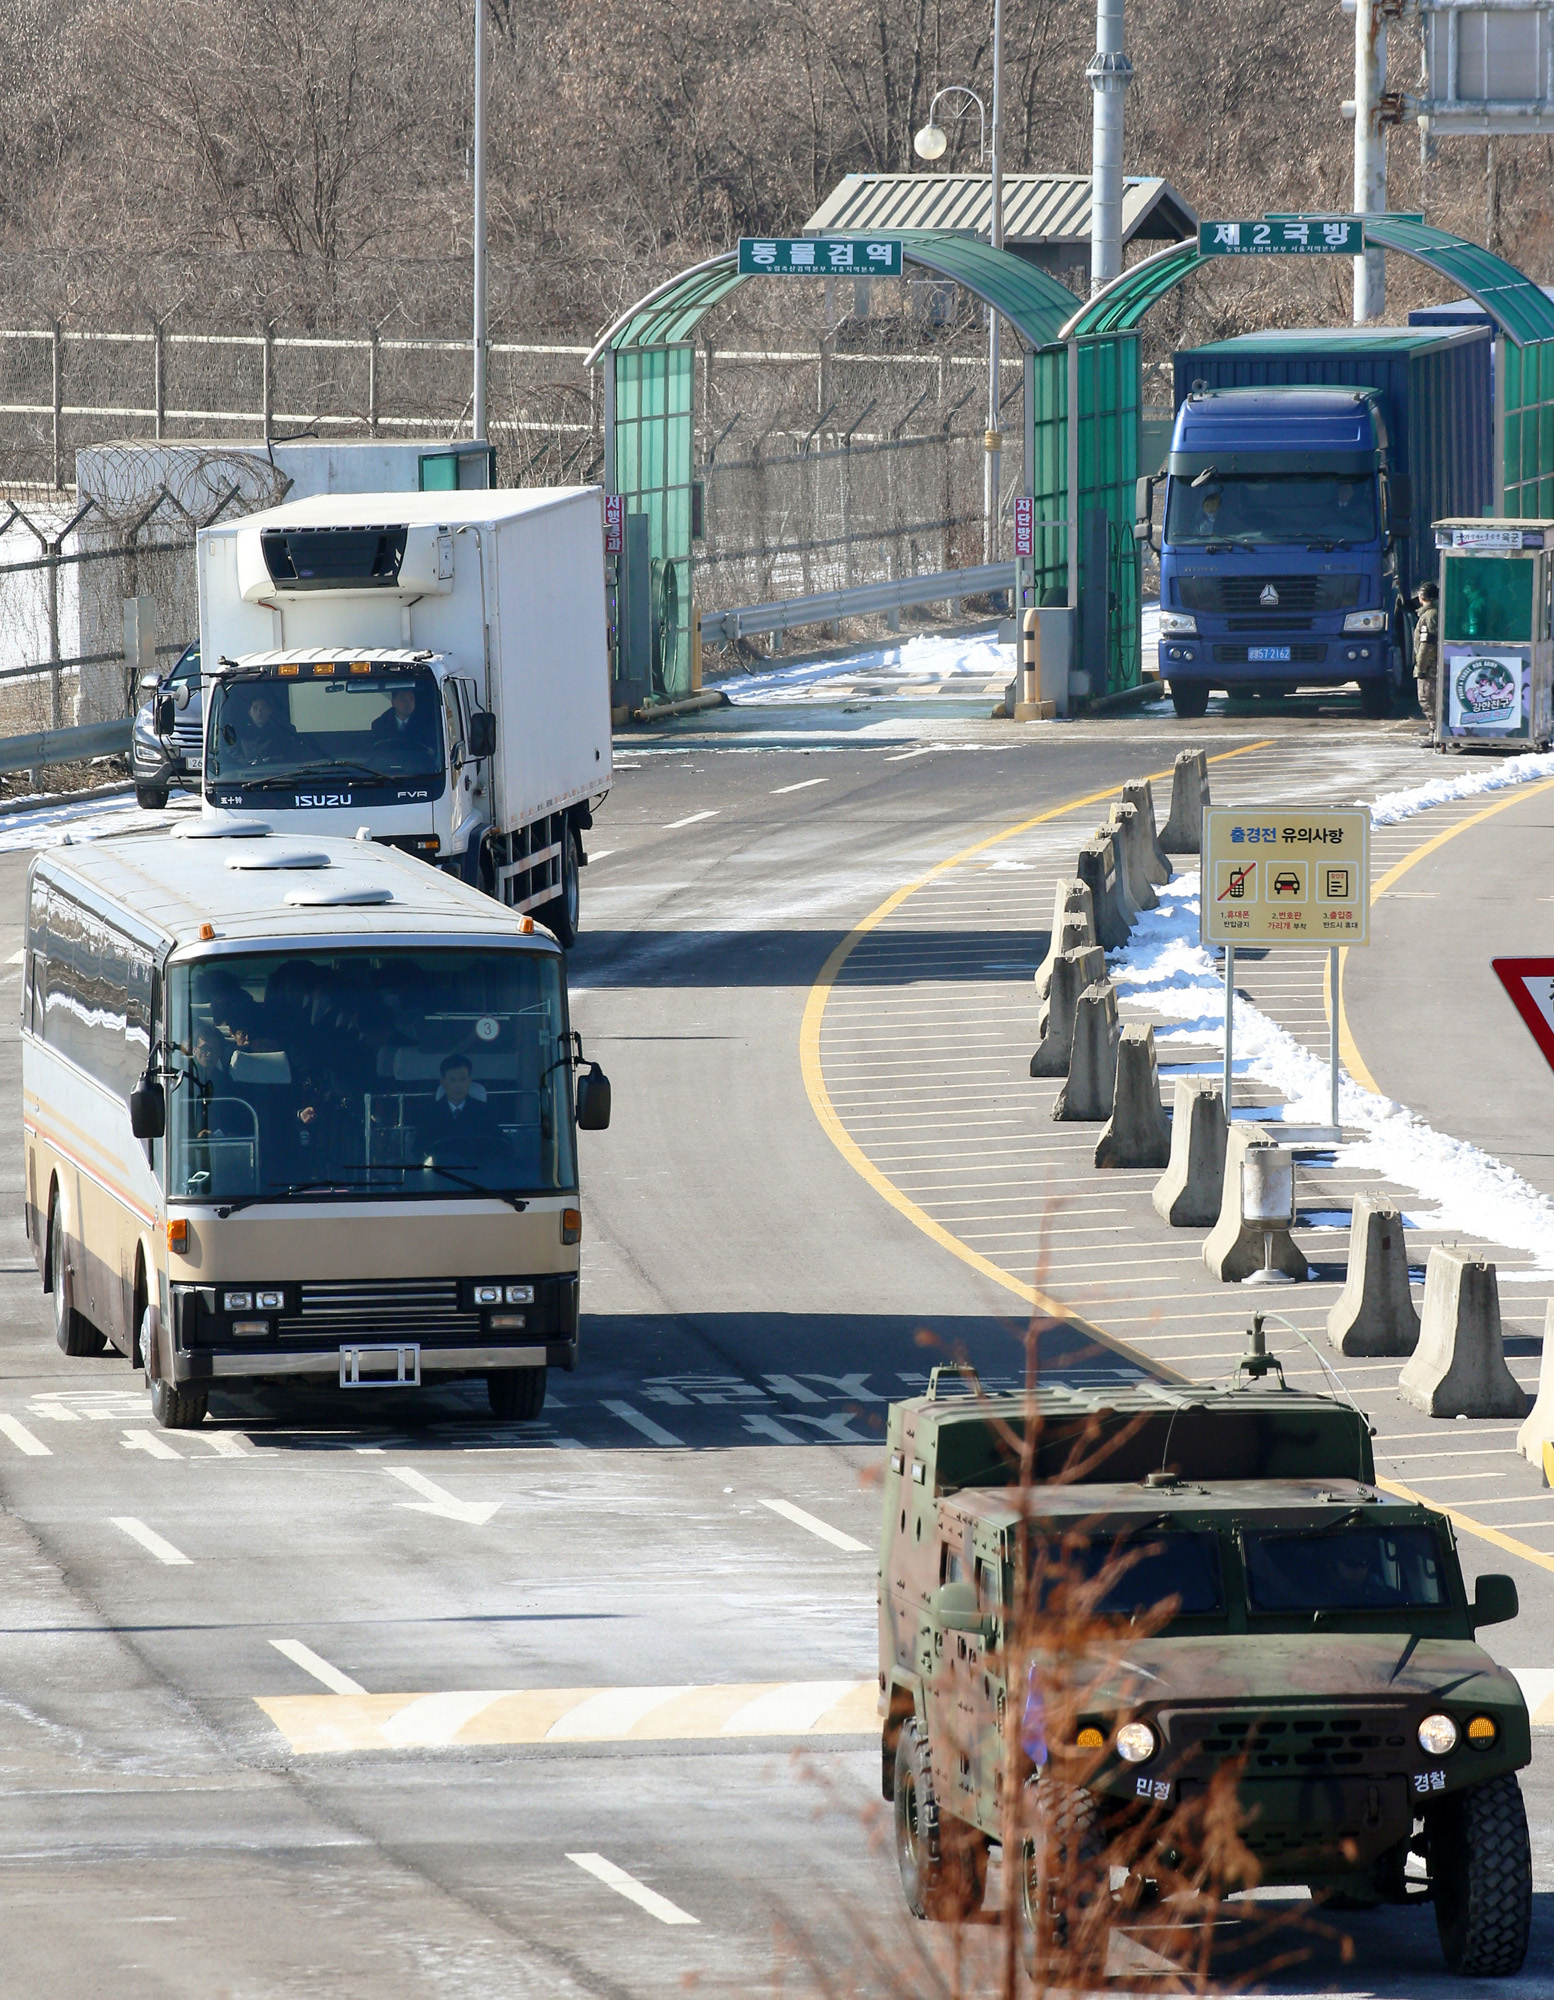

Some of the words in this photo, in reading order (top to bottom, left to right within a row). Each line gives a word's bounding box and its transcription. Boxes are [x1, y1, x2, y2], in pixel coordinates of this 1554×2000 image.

[397, 790, 428, 798] FVR
[295, 794, 352, 807] ISUZU
[1230, 827, 1277, 843] 출경전
[1281, 828, 1344, 844] 유의사항
[1268, 921, 1291, 930] 가리개
[484, 1023, 491, 1035] 3
[1135, 1777, 1171, 1800] 민정
[1414, 1771, 1447, 1793] 경찰
